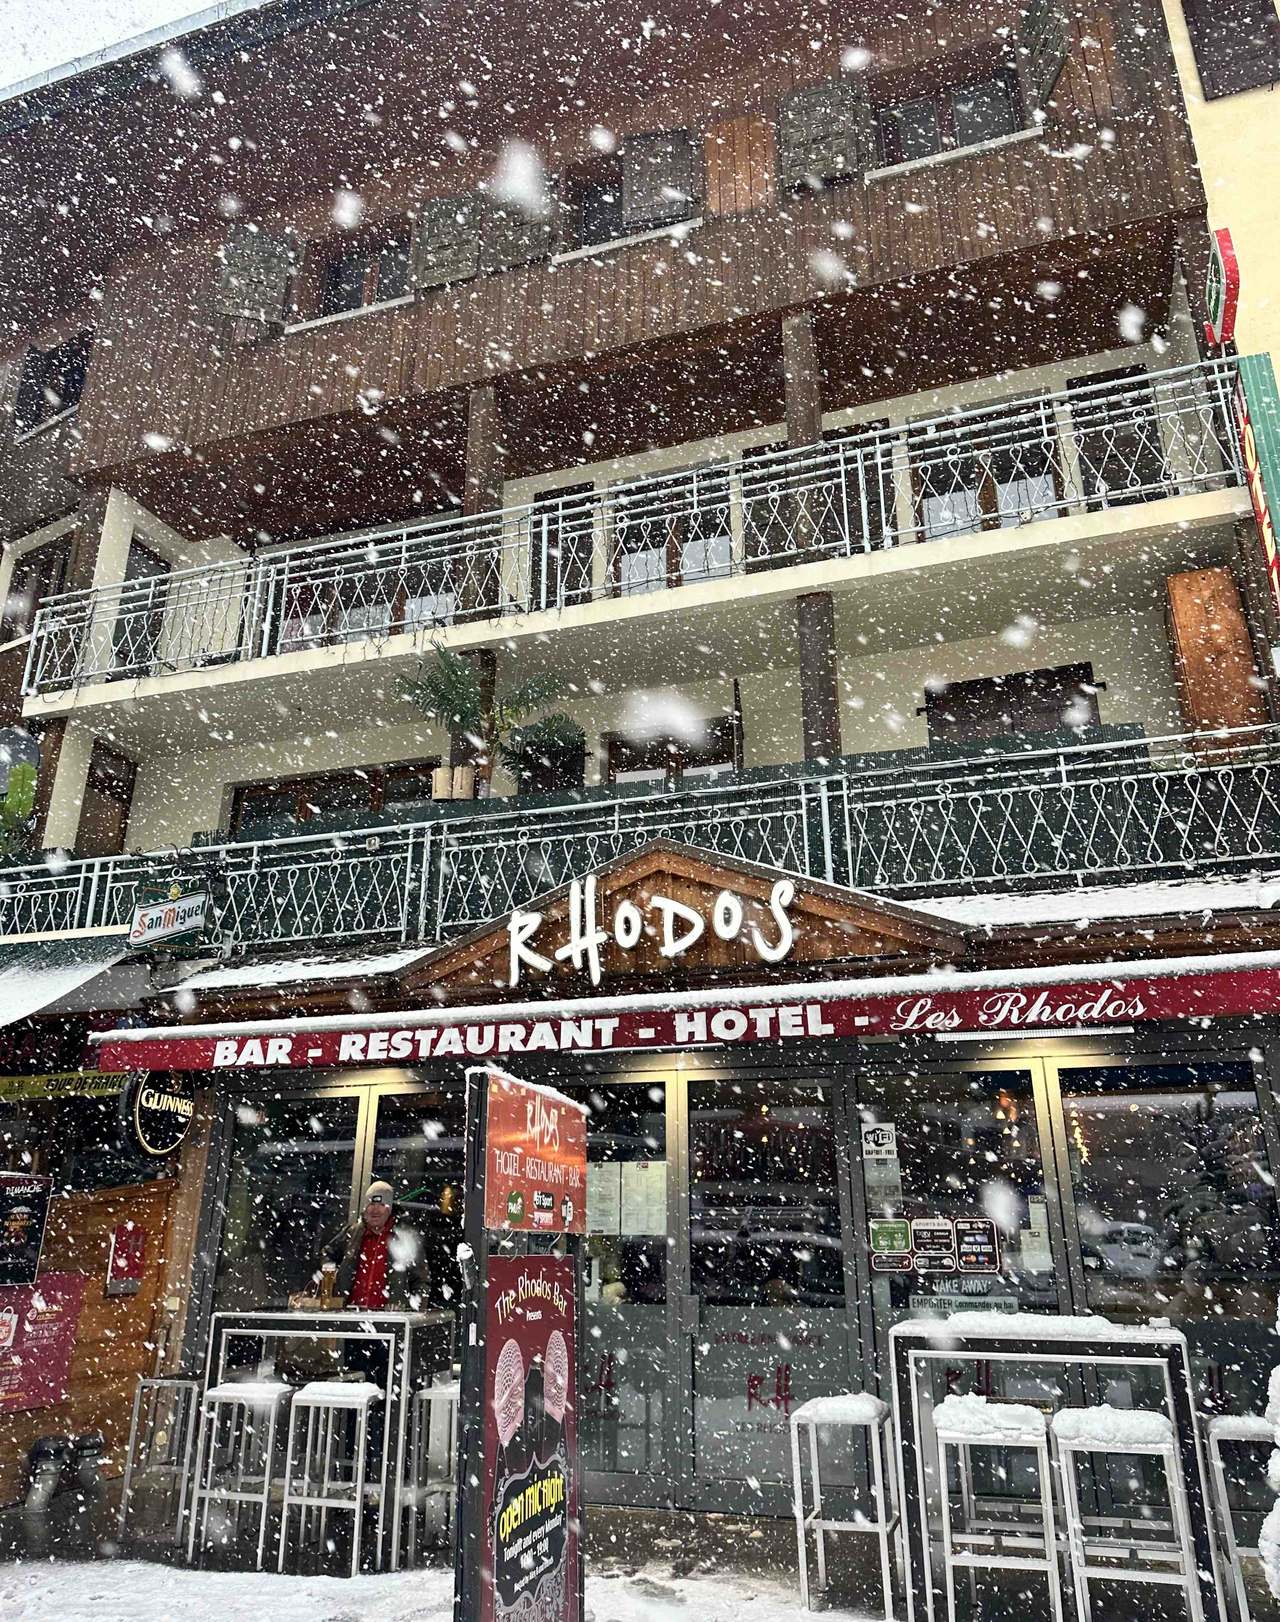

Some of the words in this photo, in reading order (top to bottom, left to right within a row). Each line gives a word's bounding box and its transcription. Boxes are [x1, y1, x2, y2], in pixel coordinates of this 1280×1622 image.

[507, 874, 794, 986] RHODOS
[212, 1036, 295, 1067] BAR
[338, 1017, 619, 1061] RESTAURANT
[675, 1004, 835, 1042] HOTEL
[890, 998, 962, 1033] Les
[982, 989, 1148, 1029] Rhodos
[88, 1073, 126, 1090] FRANC
[141, 1088, 195, 1117] GUINNESS
[496, 1150, 521, 1178] HOTEL
[526, 1157, 566, 1184] RESTAURANT
[569, 1167, 580, 1188] BAR
[5, 1184, 43, 1195] DIMANCHE
[495, 1289, 517, 1325] The
[518, 1268, 552, 1301] Rhodos
[553, 1281, 567, 1318] Bar
[934, 1279, 959, 1293] TAKE
[912, 1297, 953, 1309] EMPORTER
[499, 1491, 525, 1543] open
[525, 1473, 542, 1521] mic
[542, 1470, 564, 1513] night
